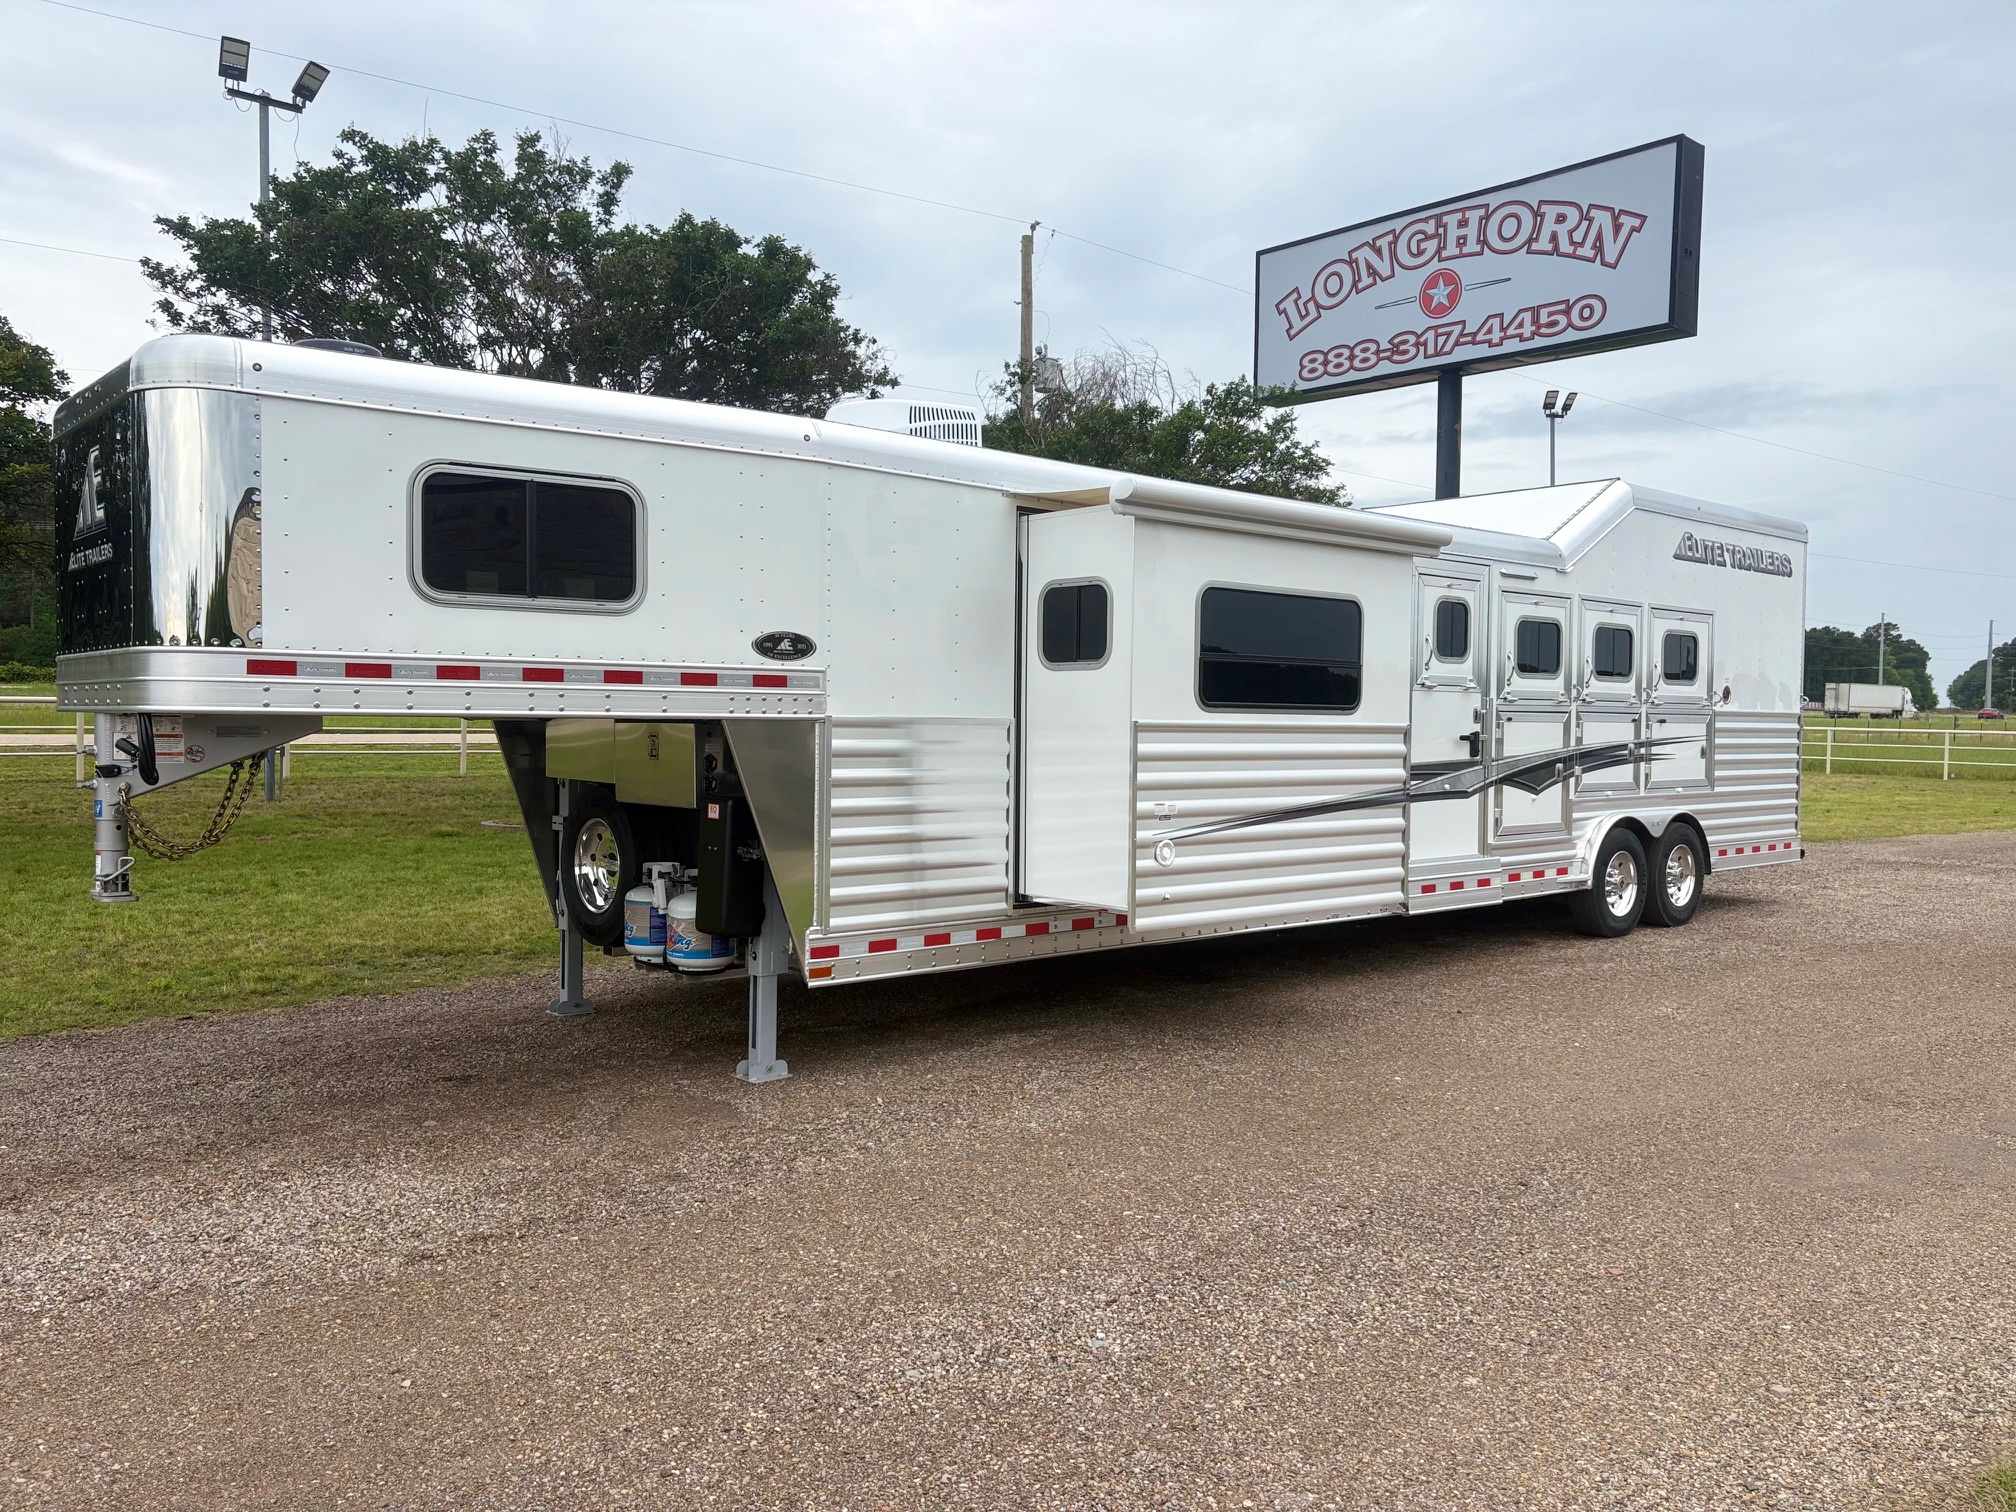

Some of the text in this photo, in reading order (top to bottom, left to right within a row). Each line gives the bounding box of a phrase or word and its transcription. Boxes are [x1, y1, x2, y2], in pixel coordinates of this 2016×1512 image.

[1275, 200, 1648, 341] LONGHORN
[1298, 294, 1607, 382] 888-317-4450
[85, 542, 113, 567] TRAILERS
[1672, 531, 1793, 578] ELITE TRAILERS
